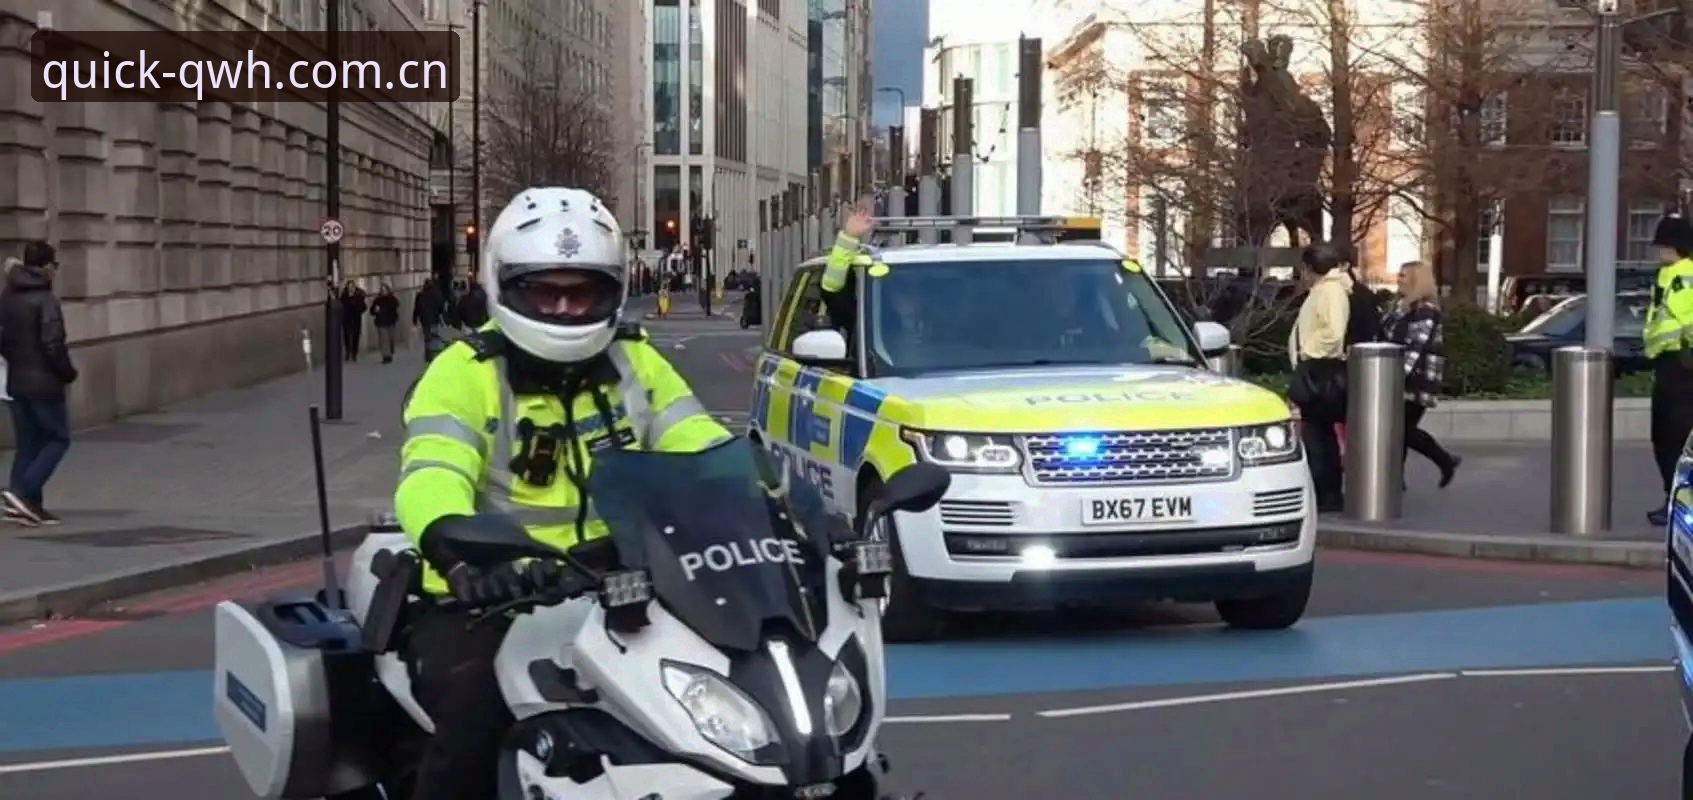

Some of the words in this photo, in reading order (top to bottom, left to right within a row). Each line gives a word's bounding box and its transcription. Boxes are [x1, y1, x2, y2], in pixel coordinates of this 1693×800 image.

[323, 225, 342, 237] 20
[1025, 391, 1197, 406] POLICE
[1092, 499, 1146, 519] BX67
[1152, 497, 1192, 517] EVM
[680, 538, 806, 581] POLICE
